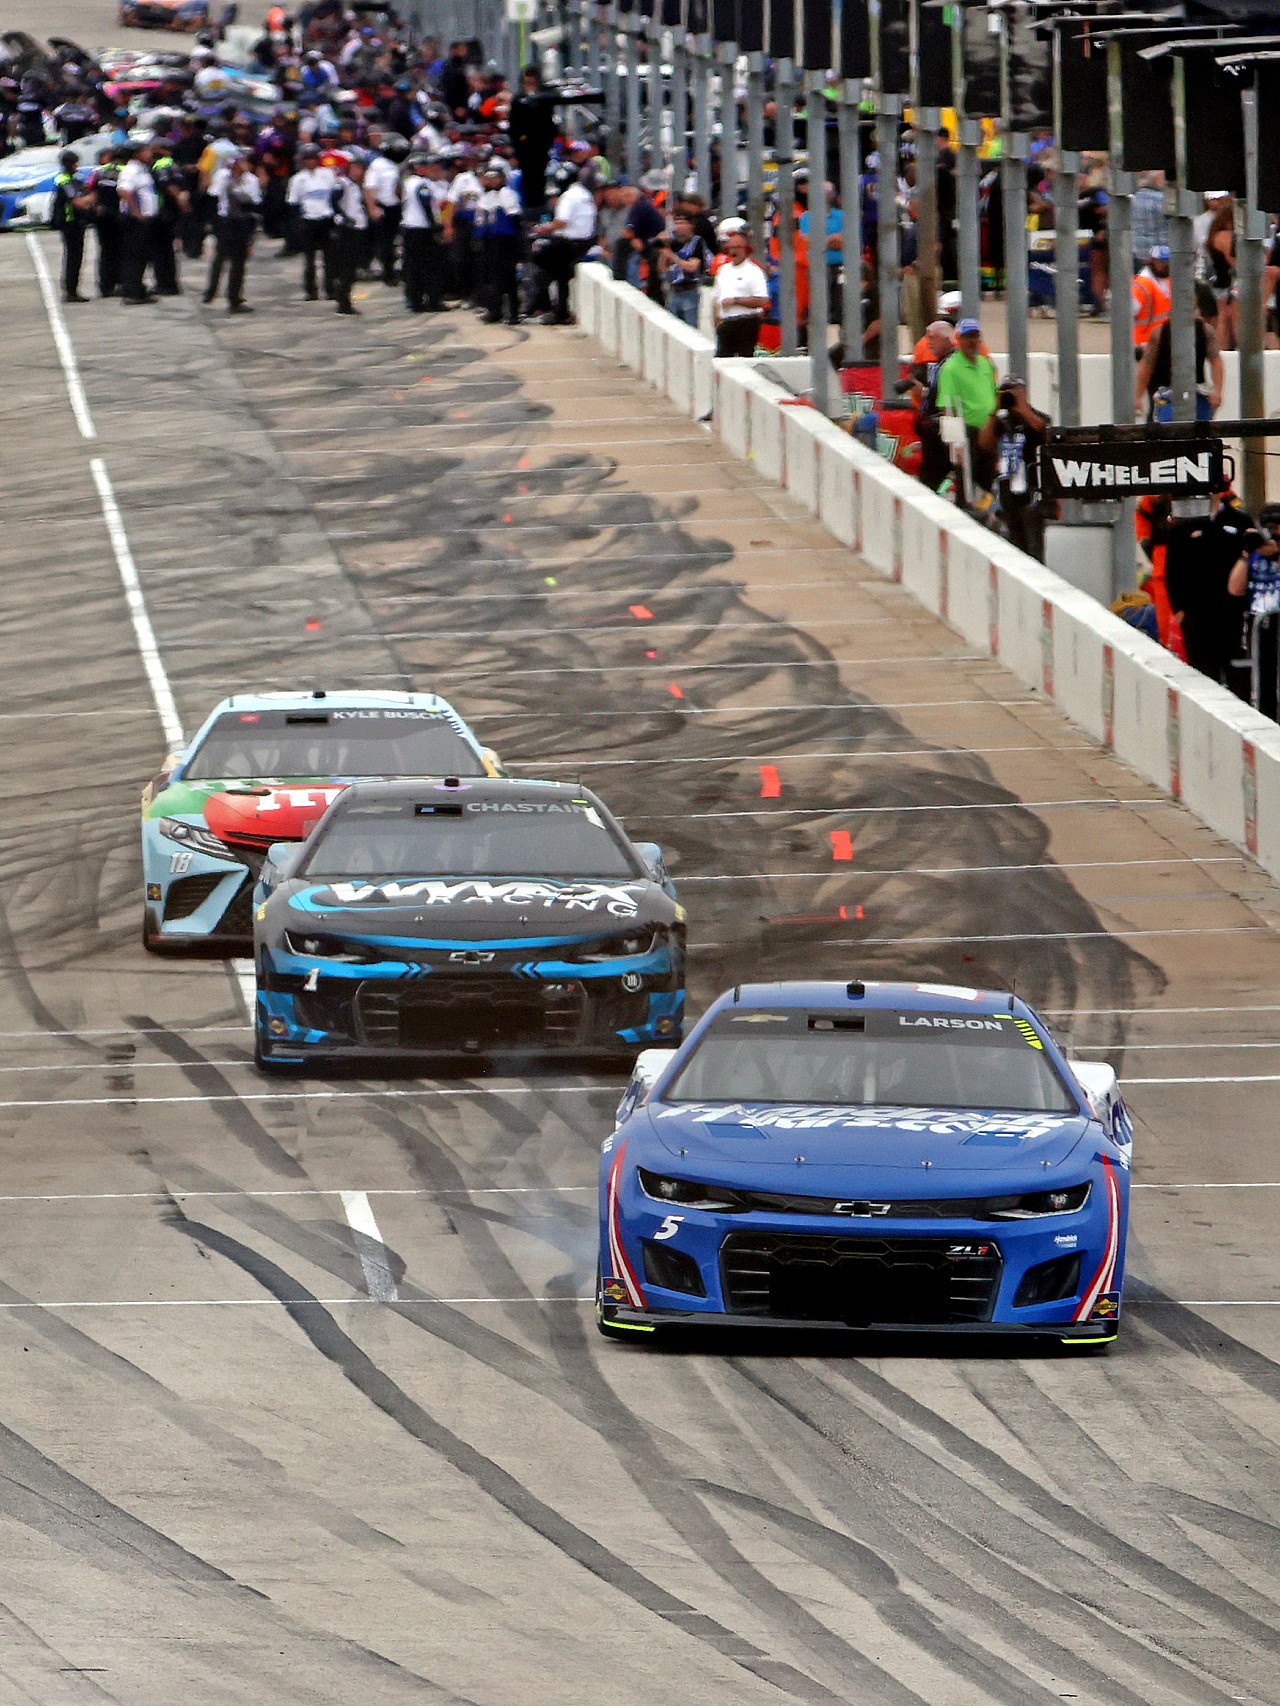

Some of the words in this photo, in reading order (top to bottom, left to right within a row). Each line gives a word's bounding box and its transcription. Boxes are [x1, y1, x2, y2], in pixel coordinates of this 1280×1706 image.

[1052, 452, 1210, 488] WHELEN
[332, 710, 380, 720] KYLE
[383, 710, 446, 720] BUSCH
[466, 802, 586, 814] CHASTAIN
[169, 851, 194, 873] 18
[425, 895, 638, 918] RACING
[303, 967, 320, 992] 1
[898, 1015, 1004, 1031] LARSON
[652, 1215, 686, 1241] 5
